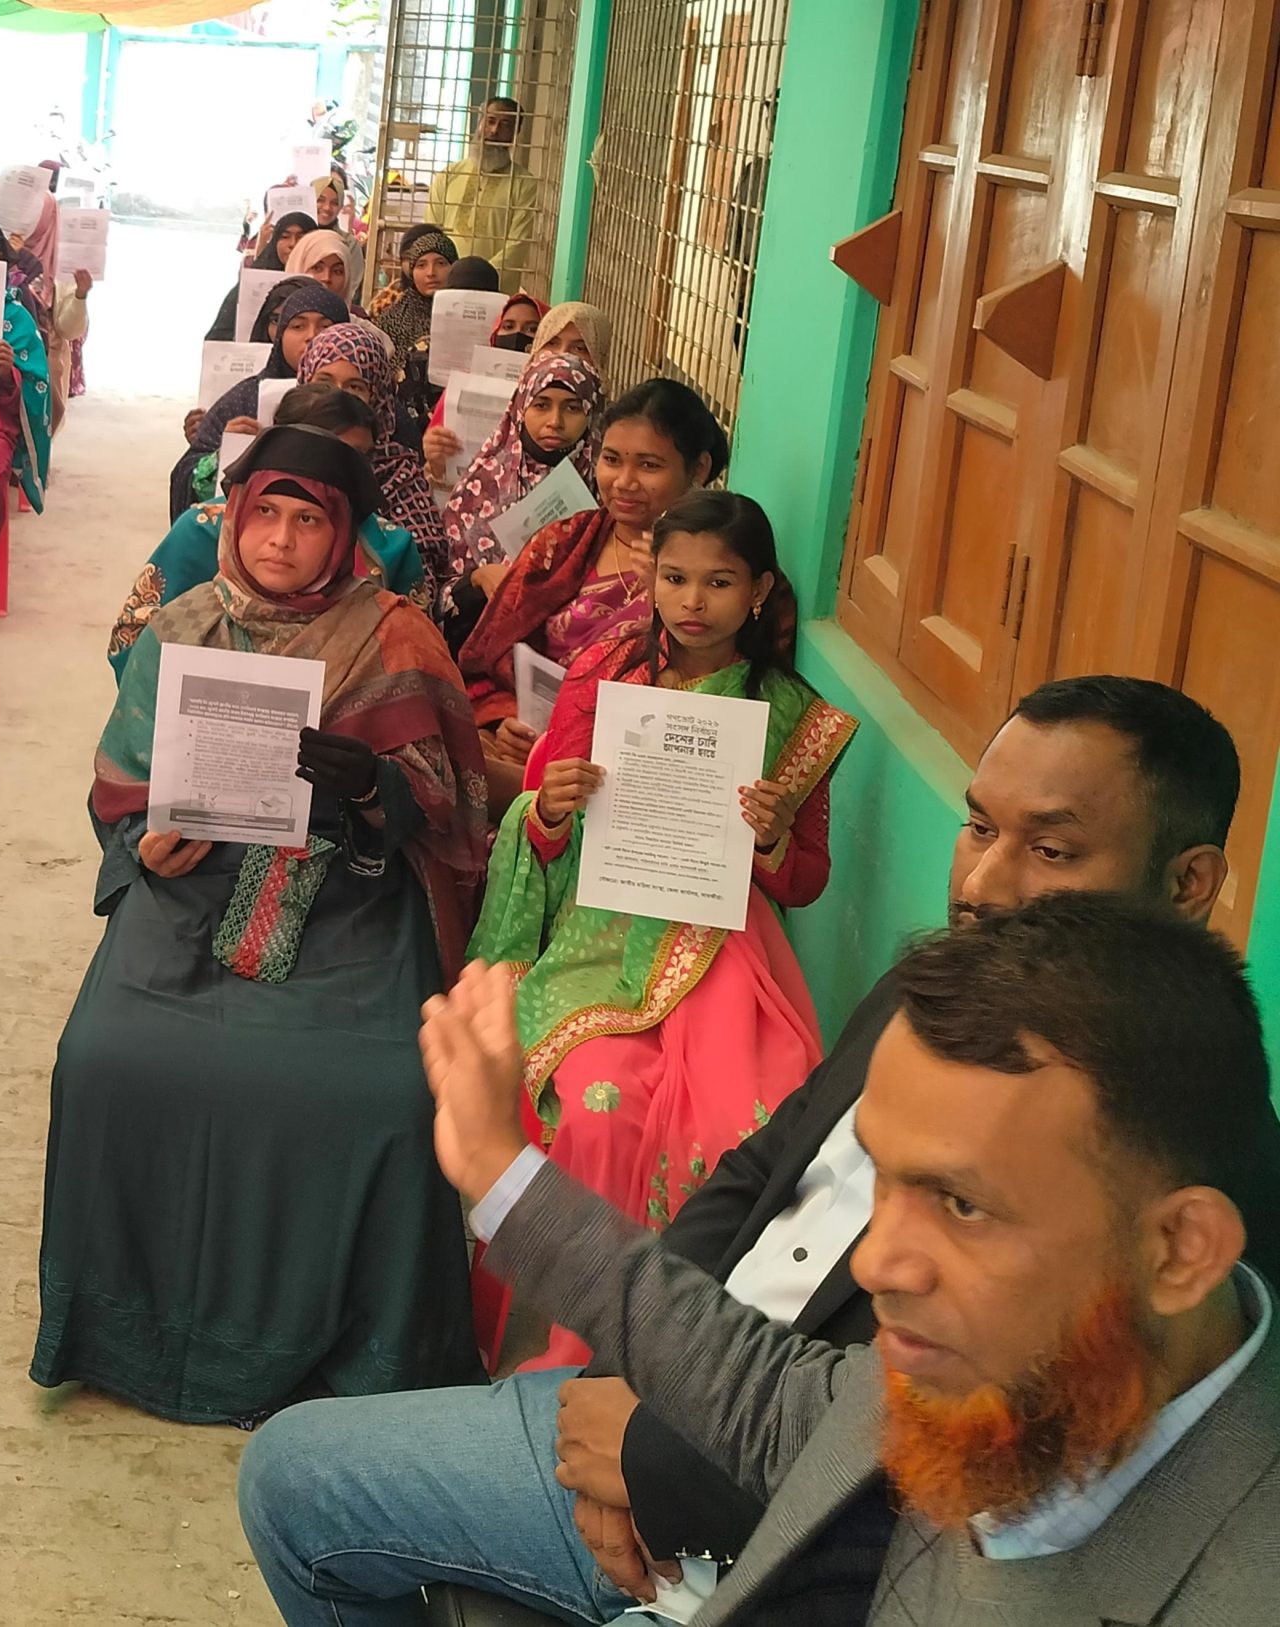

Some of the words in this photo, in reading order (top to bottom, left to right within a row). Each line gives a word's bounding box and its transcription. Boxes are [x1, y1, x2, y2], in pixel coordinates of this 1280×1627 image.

[664, 733, 694, 745] দেশের
[698, 736, 717, 748] চাবি
[663, 743, 695, 755] আপনার
[698, 748, 716, 758] হাতে
